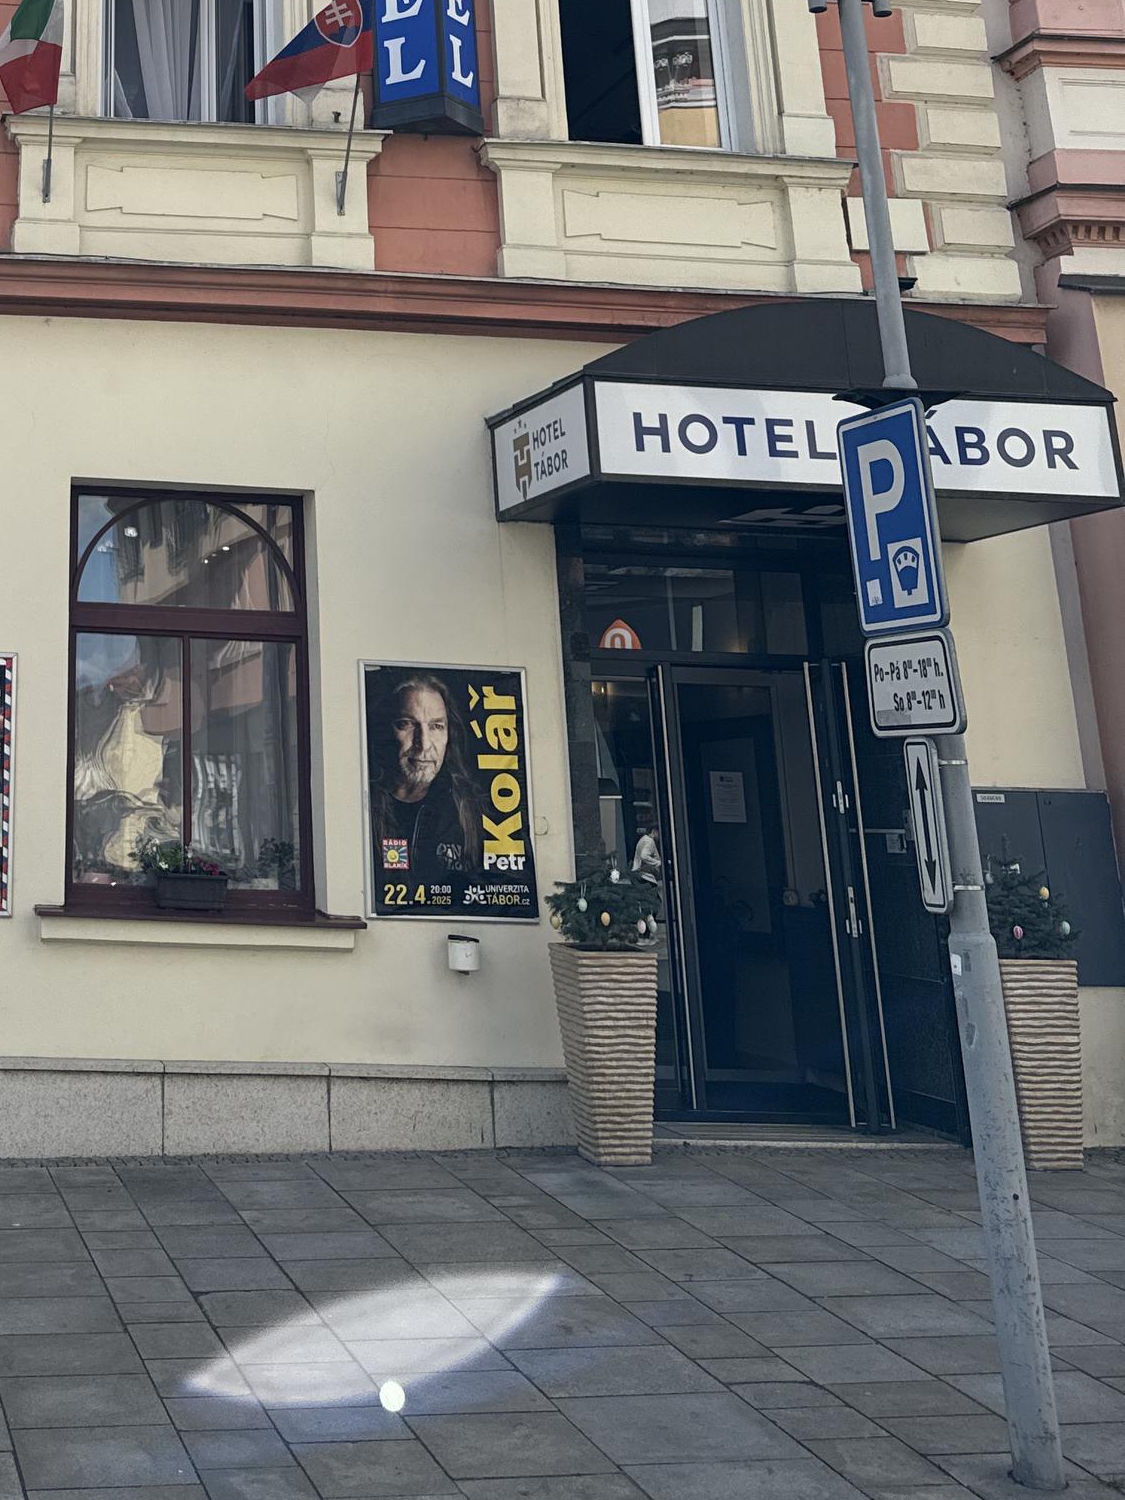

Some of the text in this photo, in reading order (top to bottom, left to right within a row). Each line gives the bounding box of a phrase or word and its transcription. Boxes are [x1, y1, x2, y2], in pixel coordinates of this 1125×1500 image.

[532, 418, 566, 451] HOTEL
[631, 409, 1080, 471] HOTEL ÁBOR
[534, 449, 569, 482] TÁBOR
[856, 439, 906, 561] P
[893, 692, 905, 712] So
[938, 689, 946, 710] h
[467, 683, 526, 856] Kolář
[483, 852, 526, 871] Petr
[430, 884, 452, 894] 20:00
[431, 895, 452, 905] 2025
[485, 884, 530, 894] UNIVERZITA
